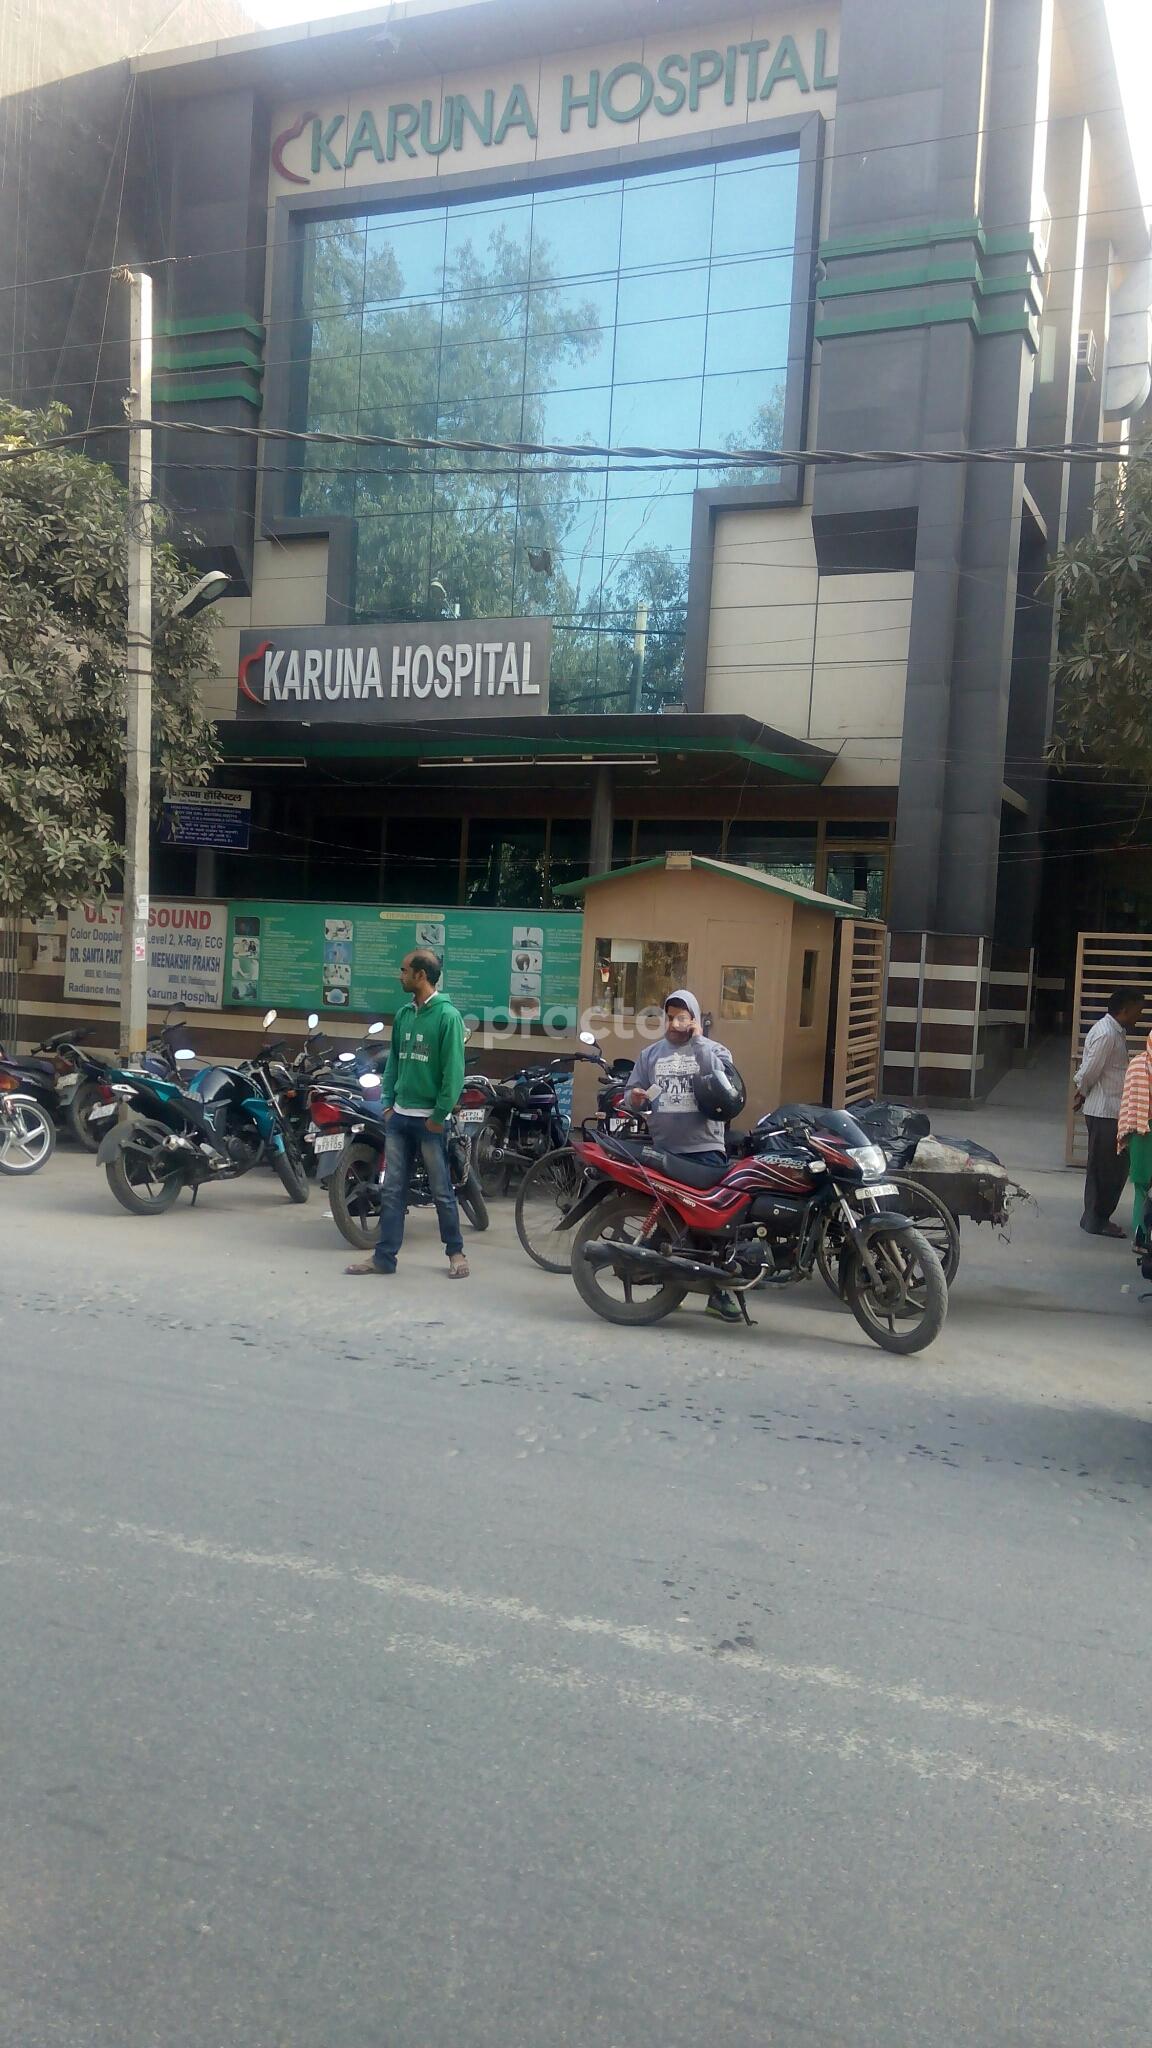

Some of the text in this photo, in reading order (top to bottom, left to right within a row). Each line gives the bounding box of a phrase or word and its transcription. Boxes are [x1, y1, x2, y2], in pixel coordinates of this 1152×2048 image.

[310, 27, 839, 173] KARUNA HOSPITAL
[263, 641, 540, 700] KARUNA HOSPITAL
[70, 927, 92, 940] Color
[204, 936, 224, 949] ECG
[68, 982, 105, 995] Radiance
[180, 988, 219, 1004] Hospital
